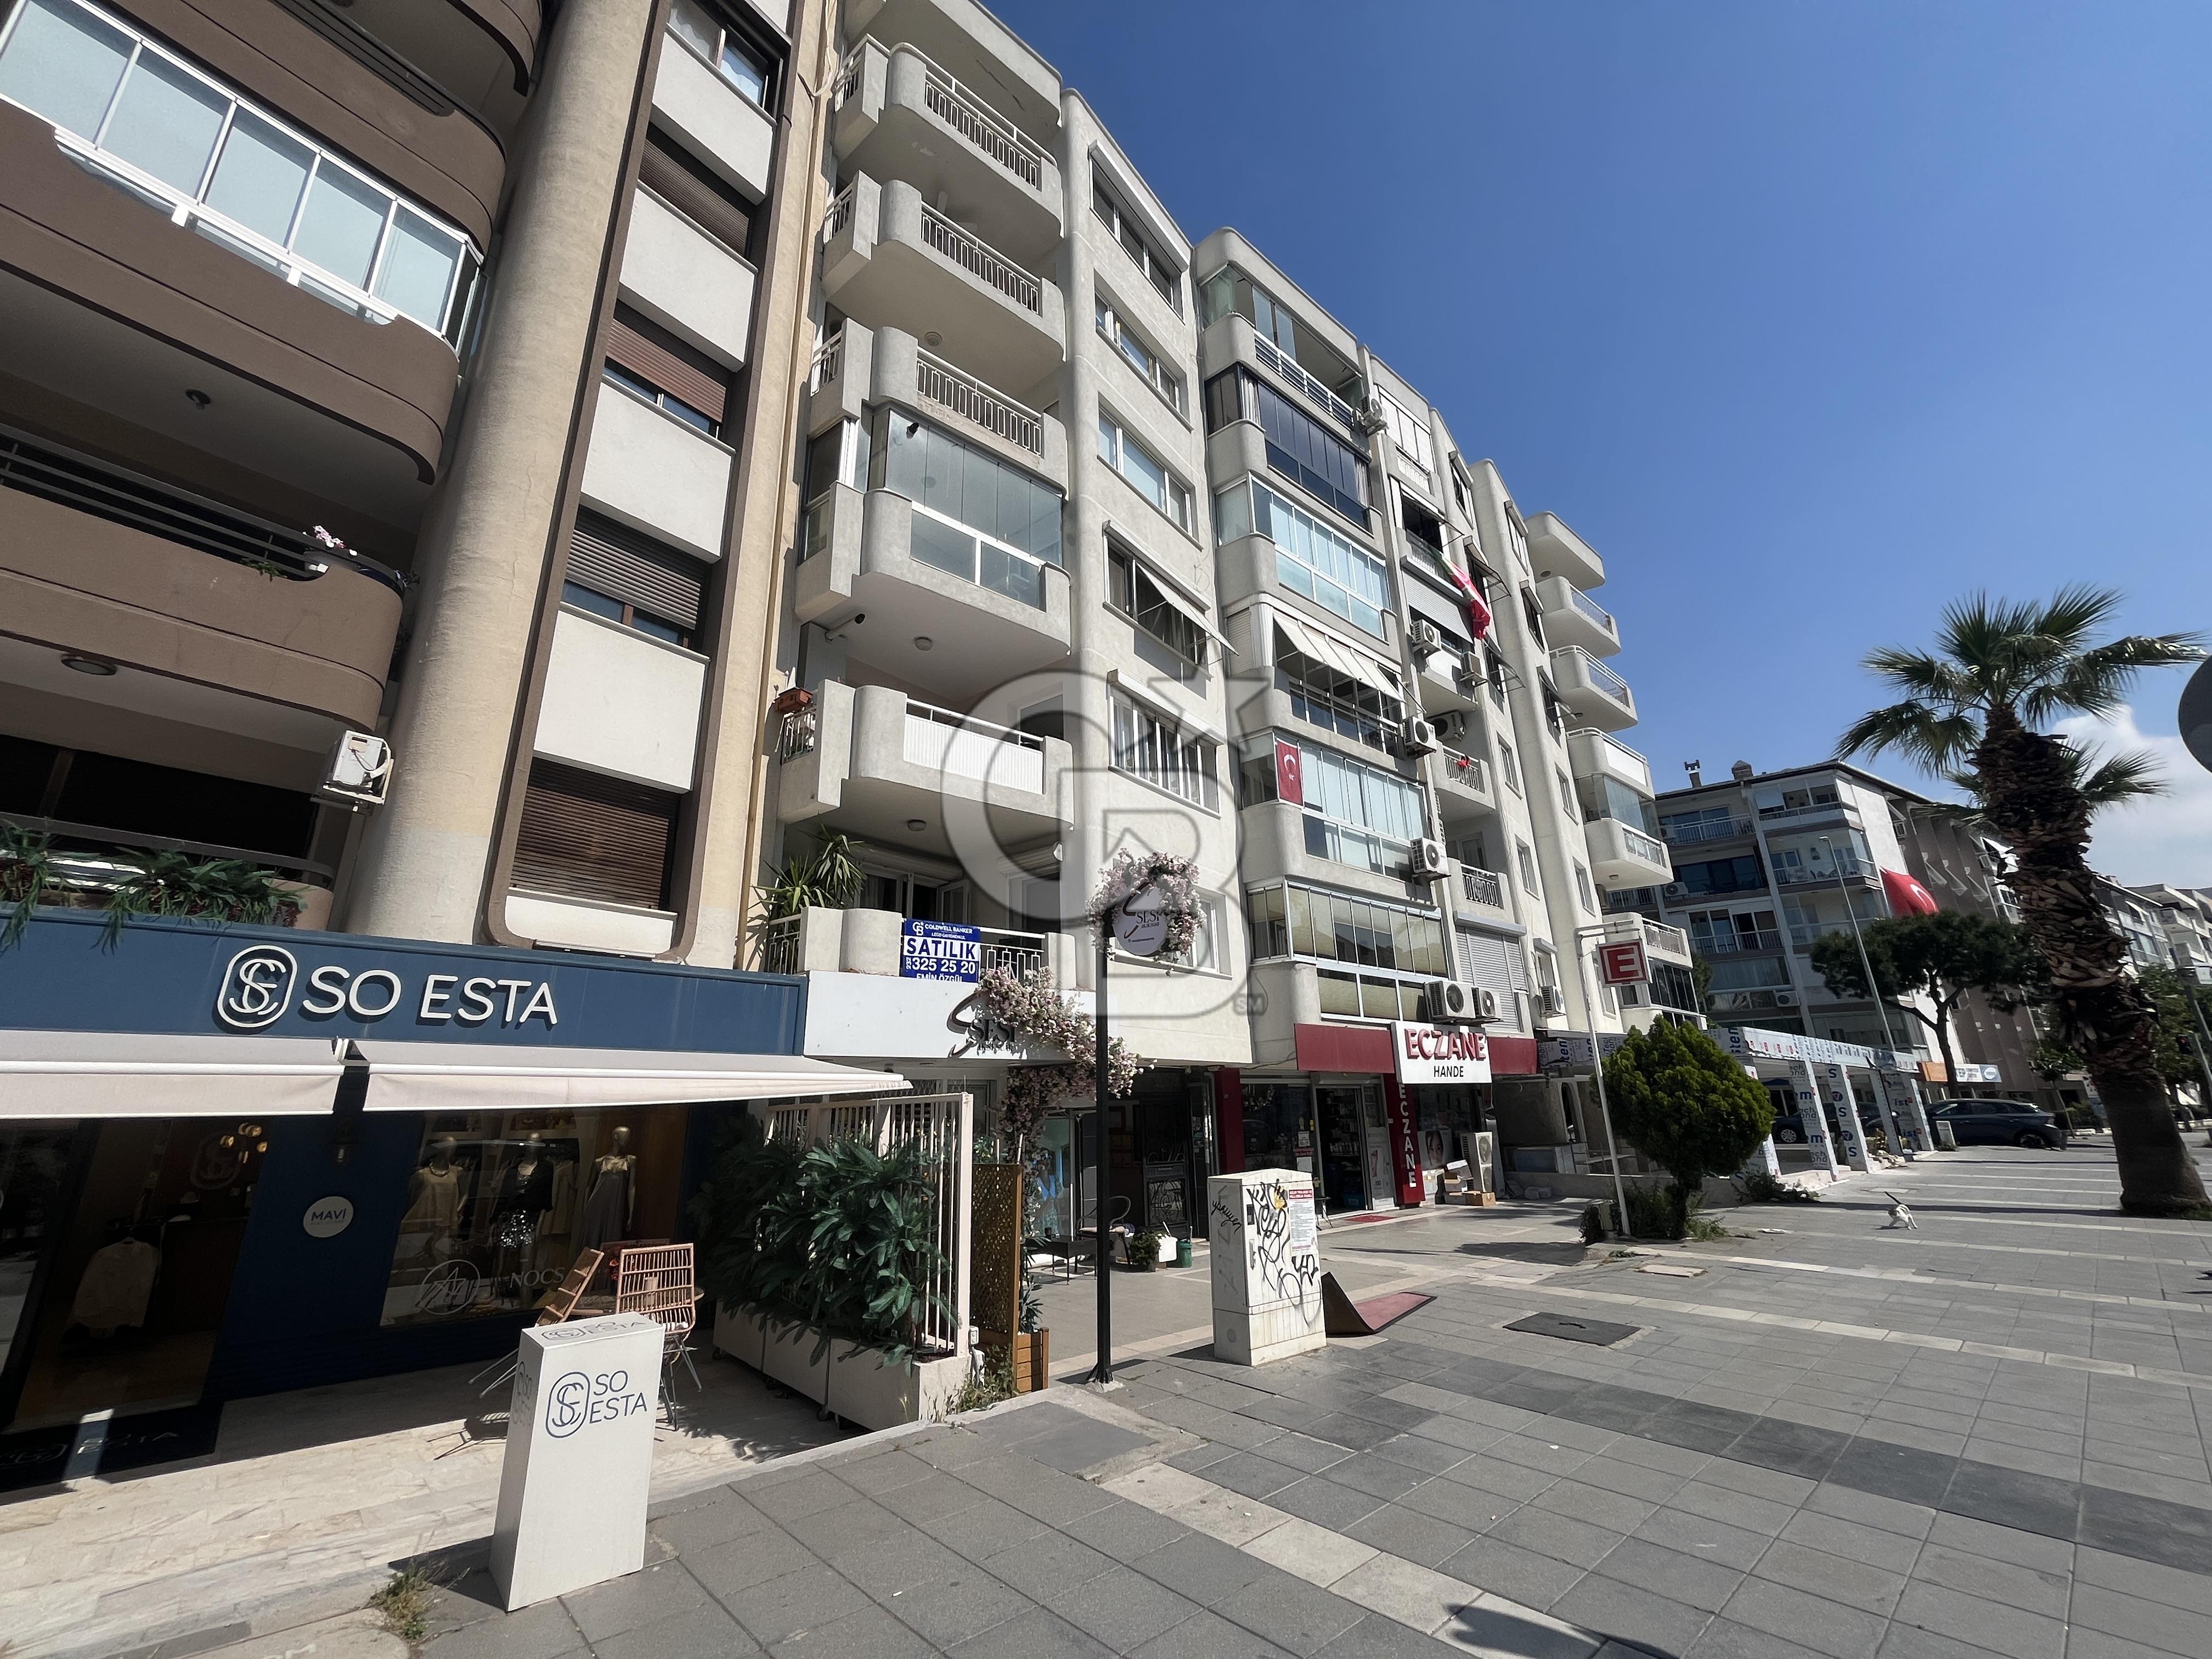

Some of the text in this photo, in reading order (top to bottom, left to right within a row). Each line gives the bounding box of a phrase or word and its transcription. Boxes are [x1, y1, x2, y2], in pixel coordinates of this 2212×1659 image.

[925, 923, 952, 932] COLDWELL
[907, 938, 976, 960] SATILIK
[912, 957, 976, 974] 325 25 20
[302, 966, 558, 1025] SO ESTA
[1404, 1028, 1486, 1061] ECZANE
[1434, 1065, 1464, 1077] HANDE
[1398, 1084, 1417, 1188] ECZANE
[594, 1370, 628, 1396] SO
[589, 1392, 647, 1424] ESTA
